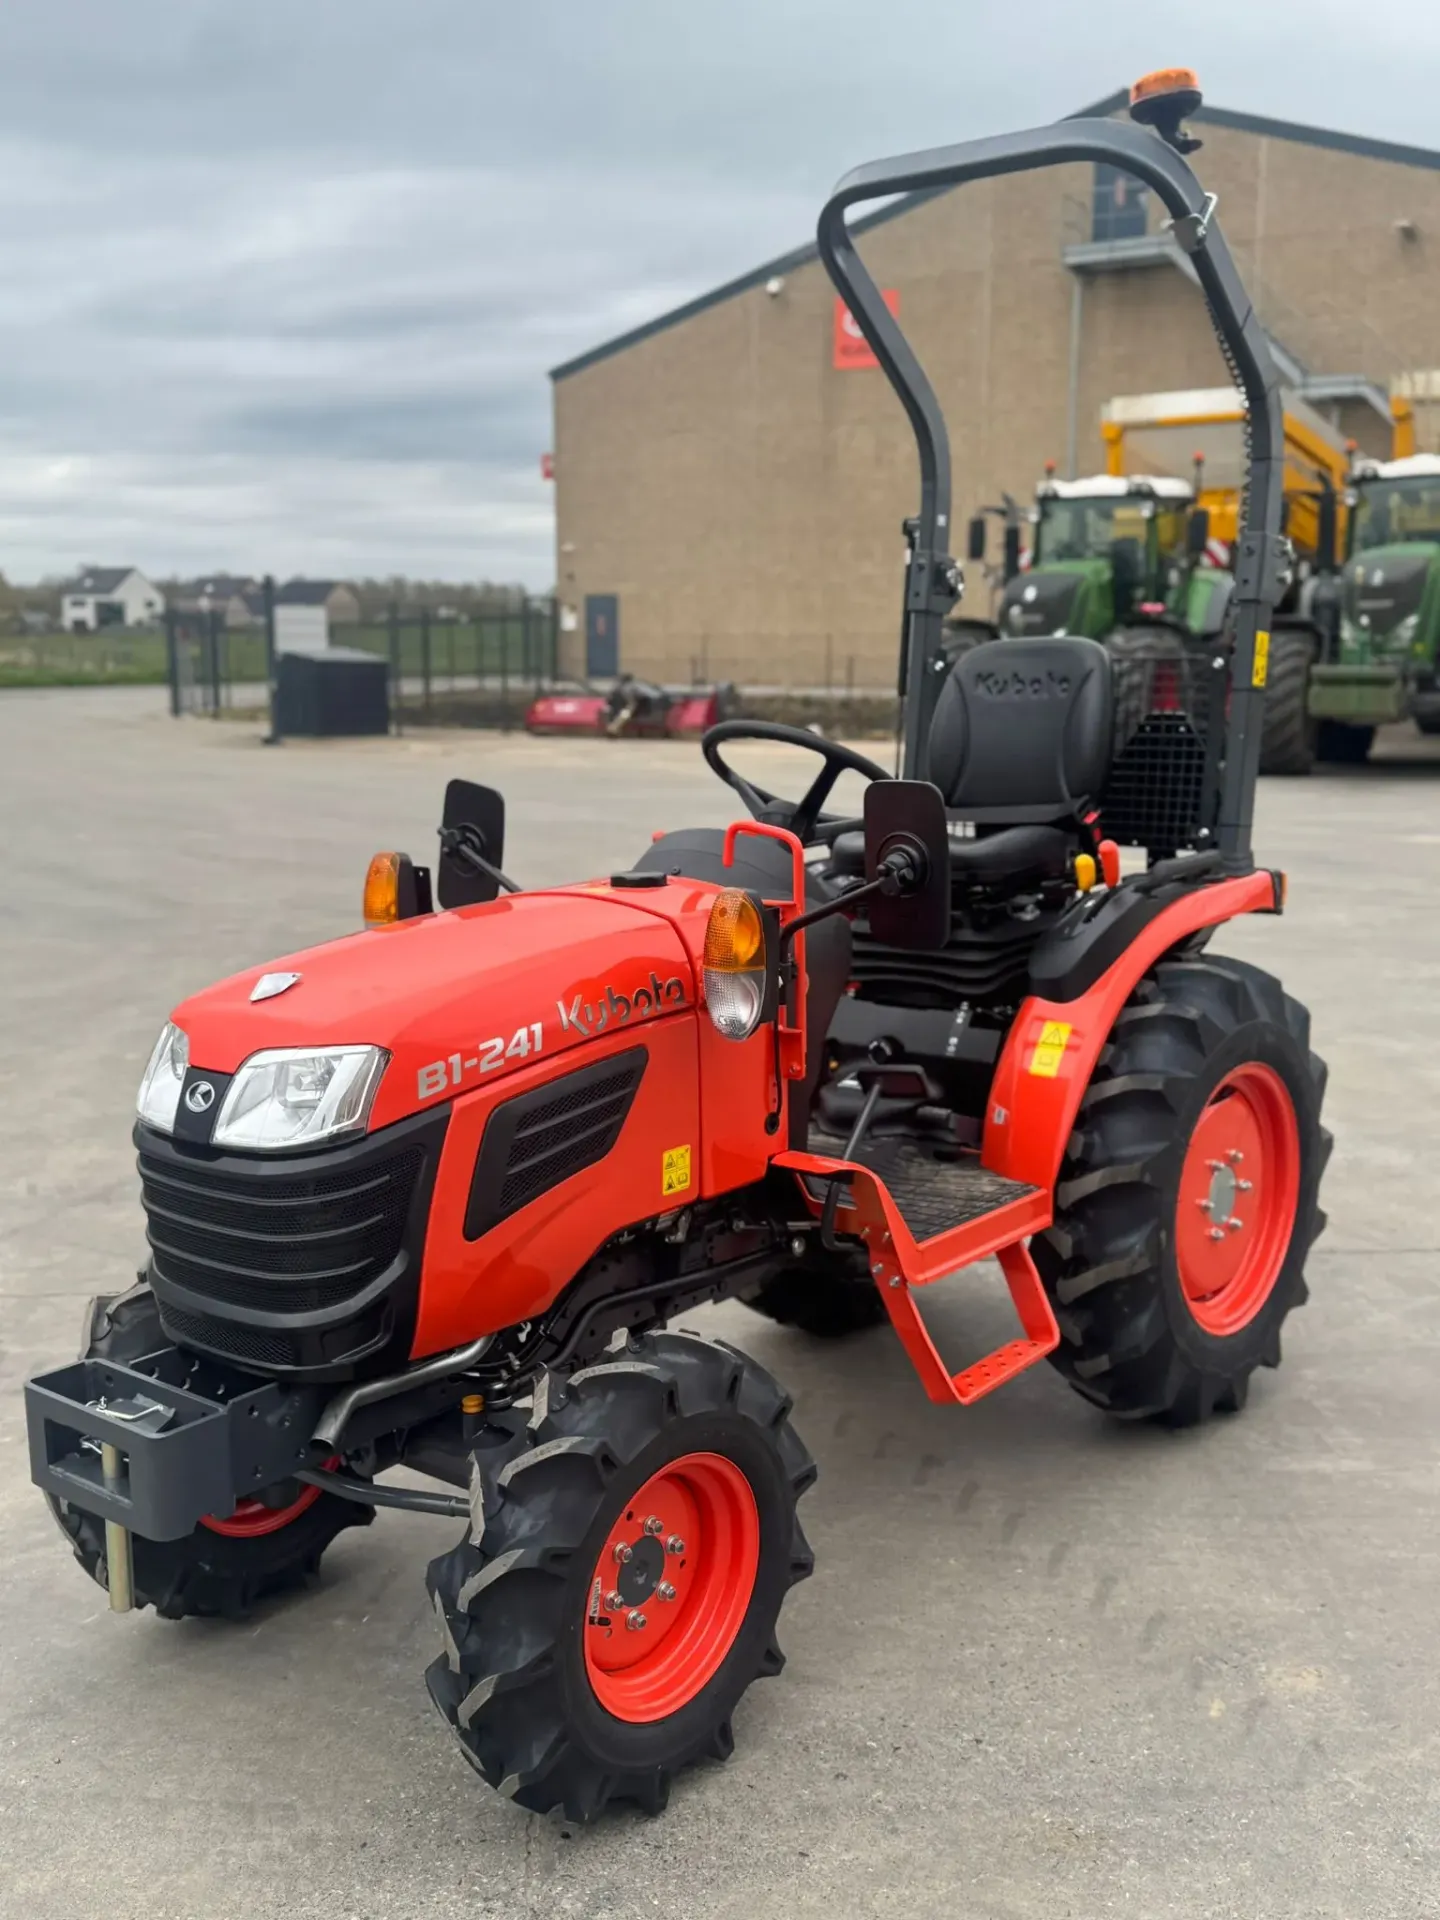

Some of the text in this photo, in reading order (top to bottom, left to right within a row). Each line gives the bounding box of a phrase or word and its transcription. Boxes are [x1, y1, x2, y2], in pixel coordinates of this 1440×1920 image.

[974, 669, 1071, 696] Kubota
[556, 972, 686, 1036] Kubota
[417, 1022, 544, 1100] B1-241
